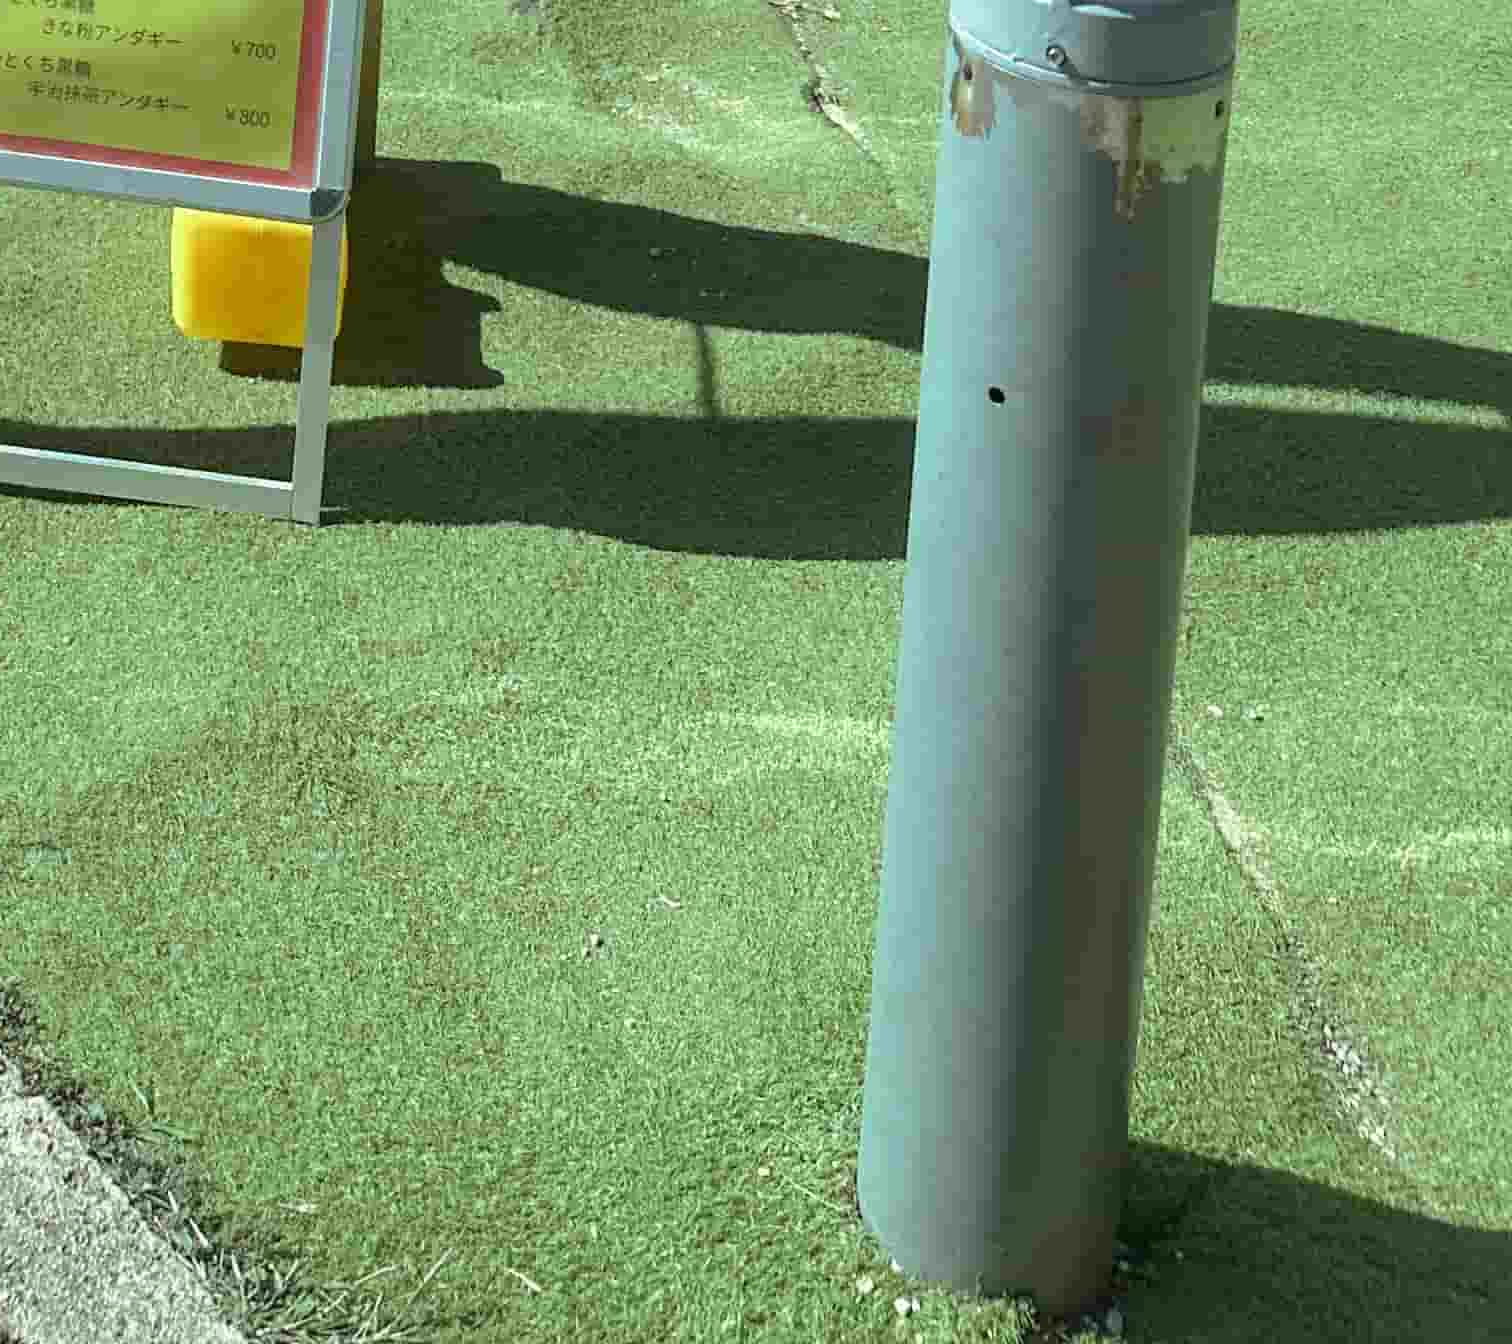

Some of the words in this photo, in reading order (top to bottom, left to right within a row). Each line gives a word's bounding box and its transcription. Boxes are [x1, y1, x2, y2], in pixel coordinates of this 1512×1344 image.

[40, 18, 185, 48] きな粉アンダギー
[231, 39, 277, 61] ¥700
